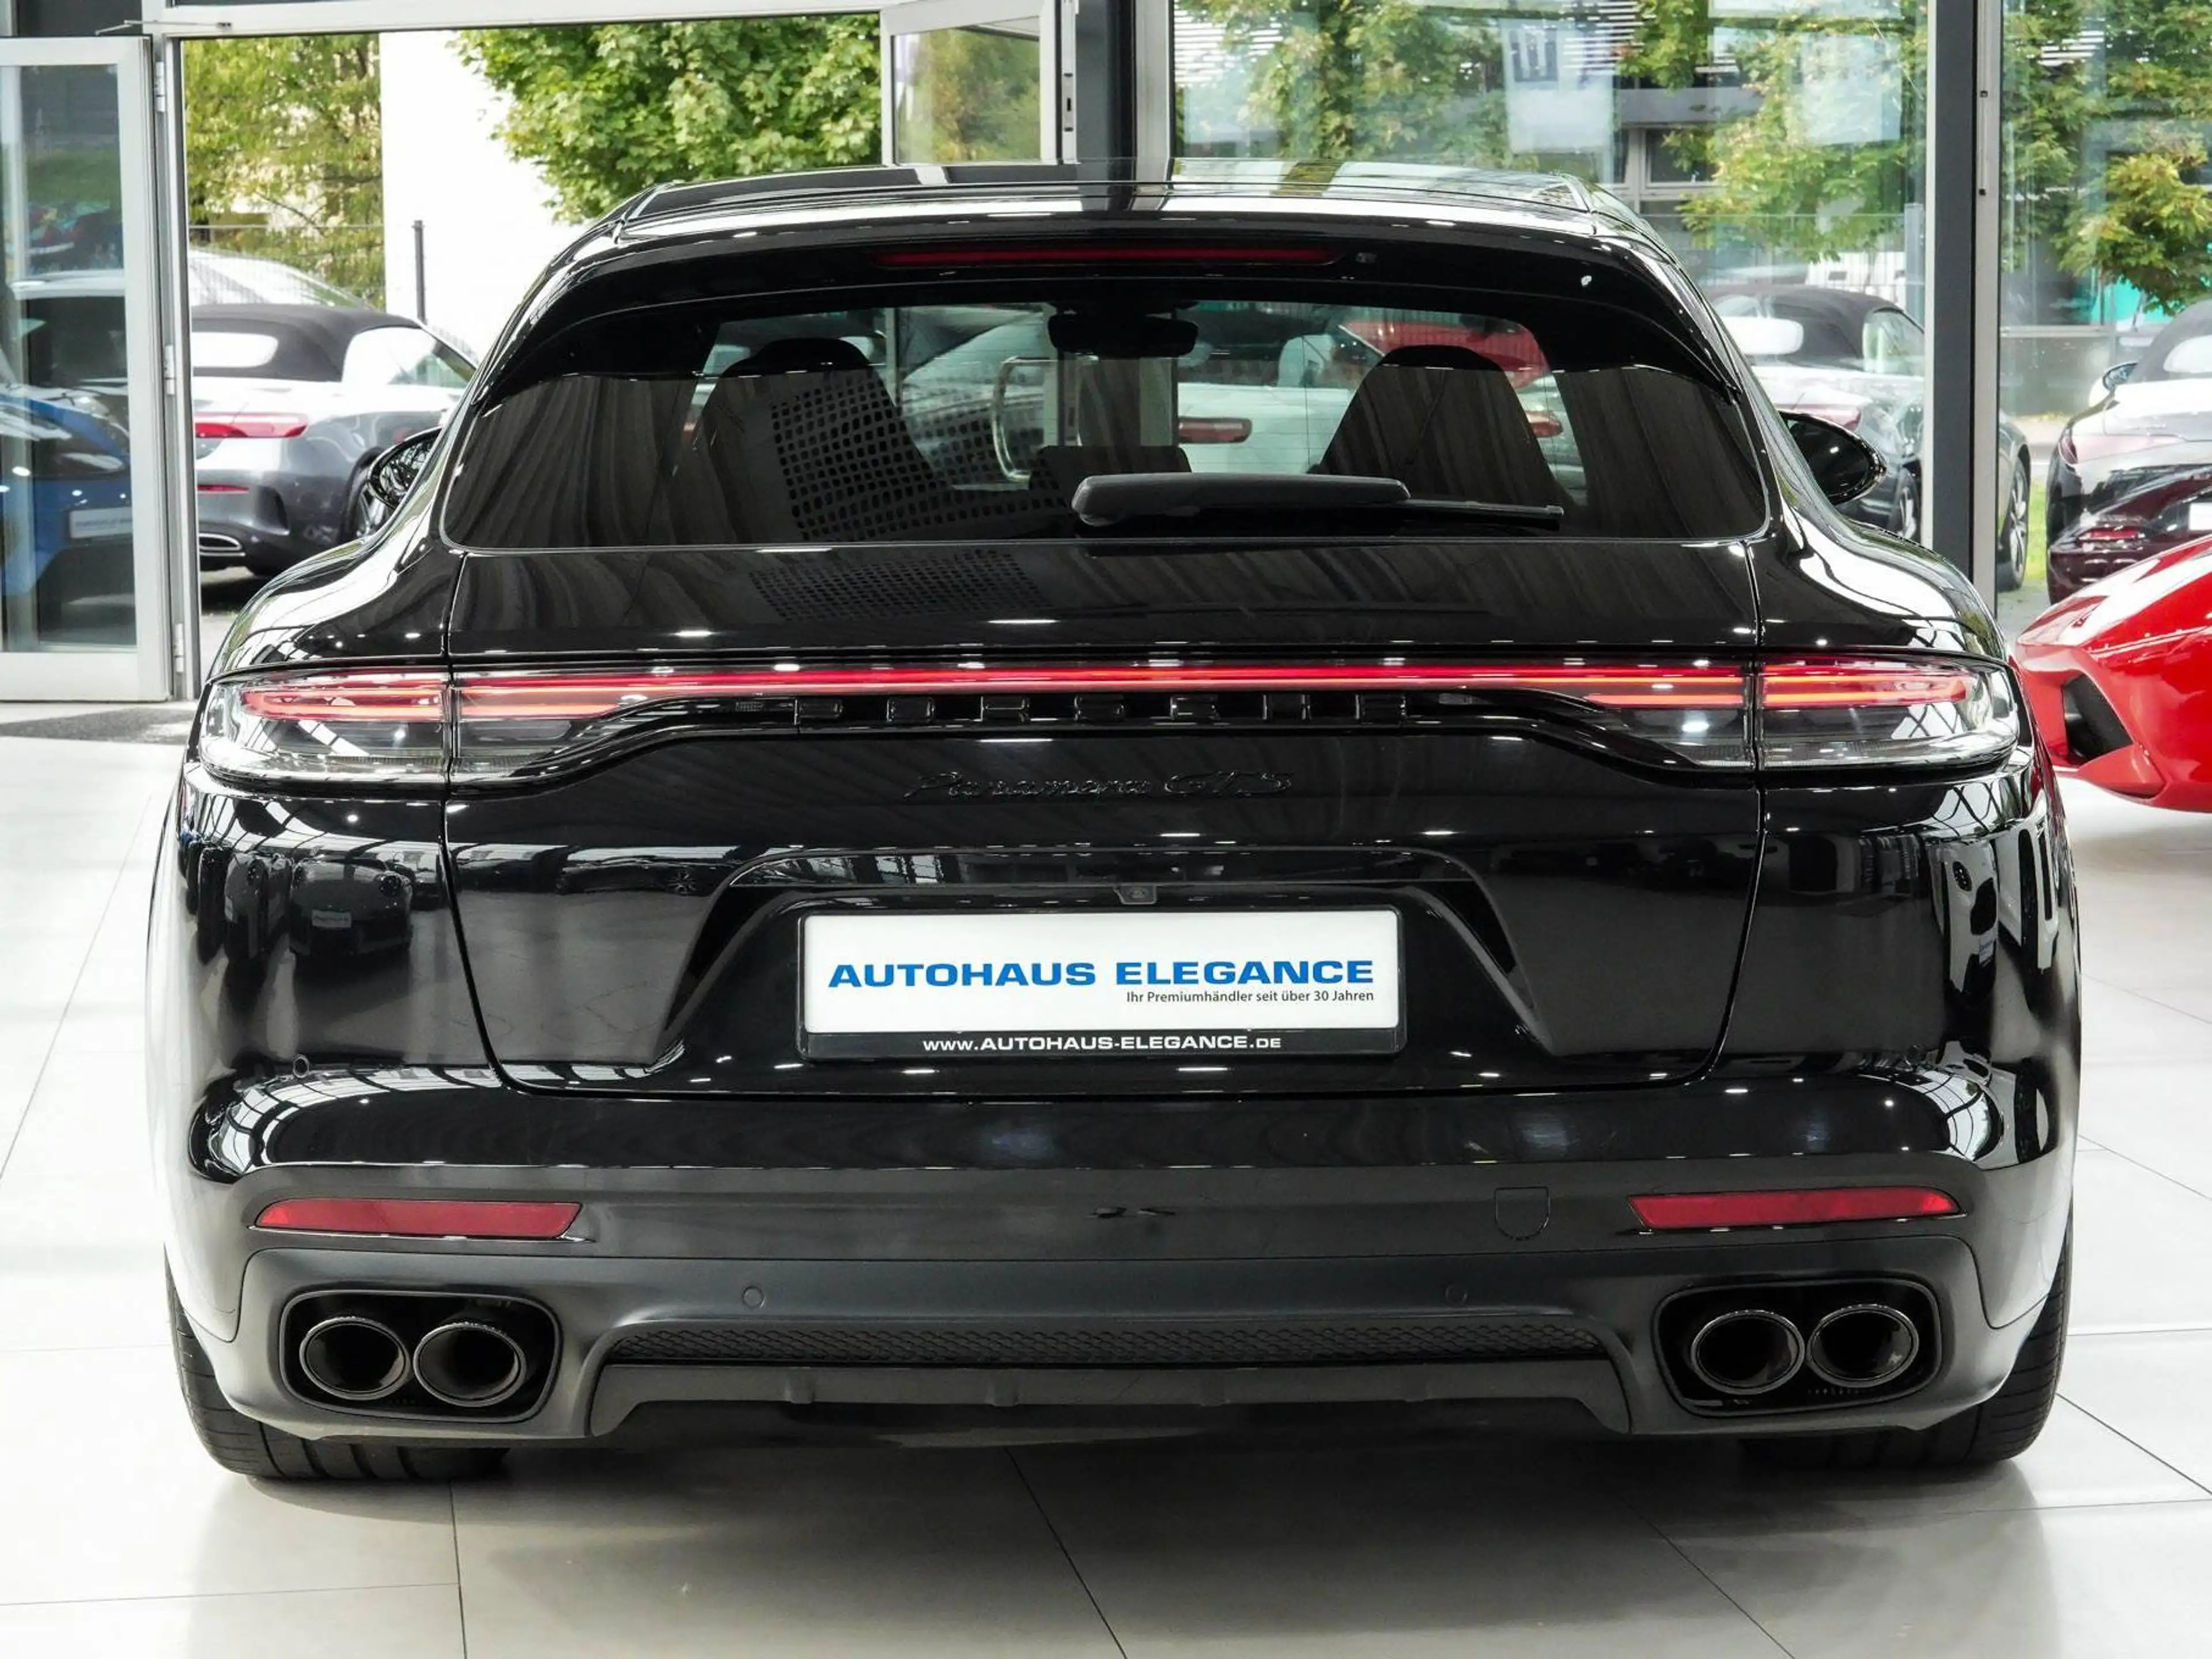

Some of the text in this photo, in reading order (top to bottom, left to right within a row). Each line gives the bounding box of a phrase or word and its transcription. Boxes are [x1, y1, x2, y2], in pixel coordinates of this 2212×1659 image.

[829, 960, 1372, 988] AUTOHAUS ELEGANCE
[1126, 990, 1374, 1002] Ihr Premiumhändler seit über 30 Jahren
[922, 1035, 1281, 1052] www.AUTOHAUS-ELEGANCE.DE
